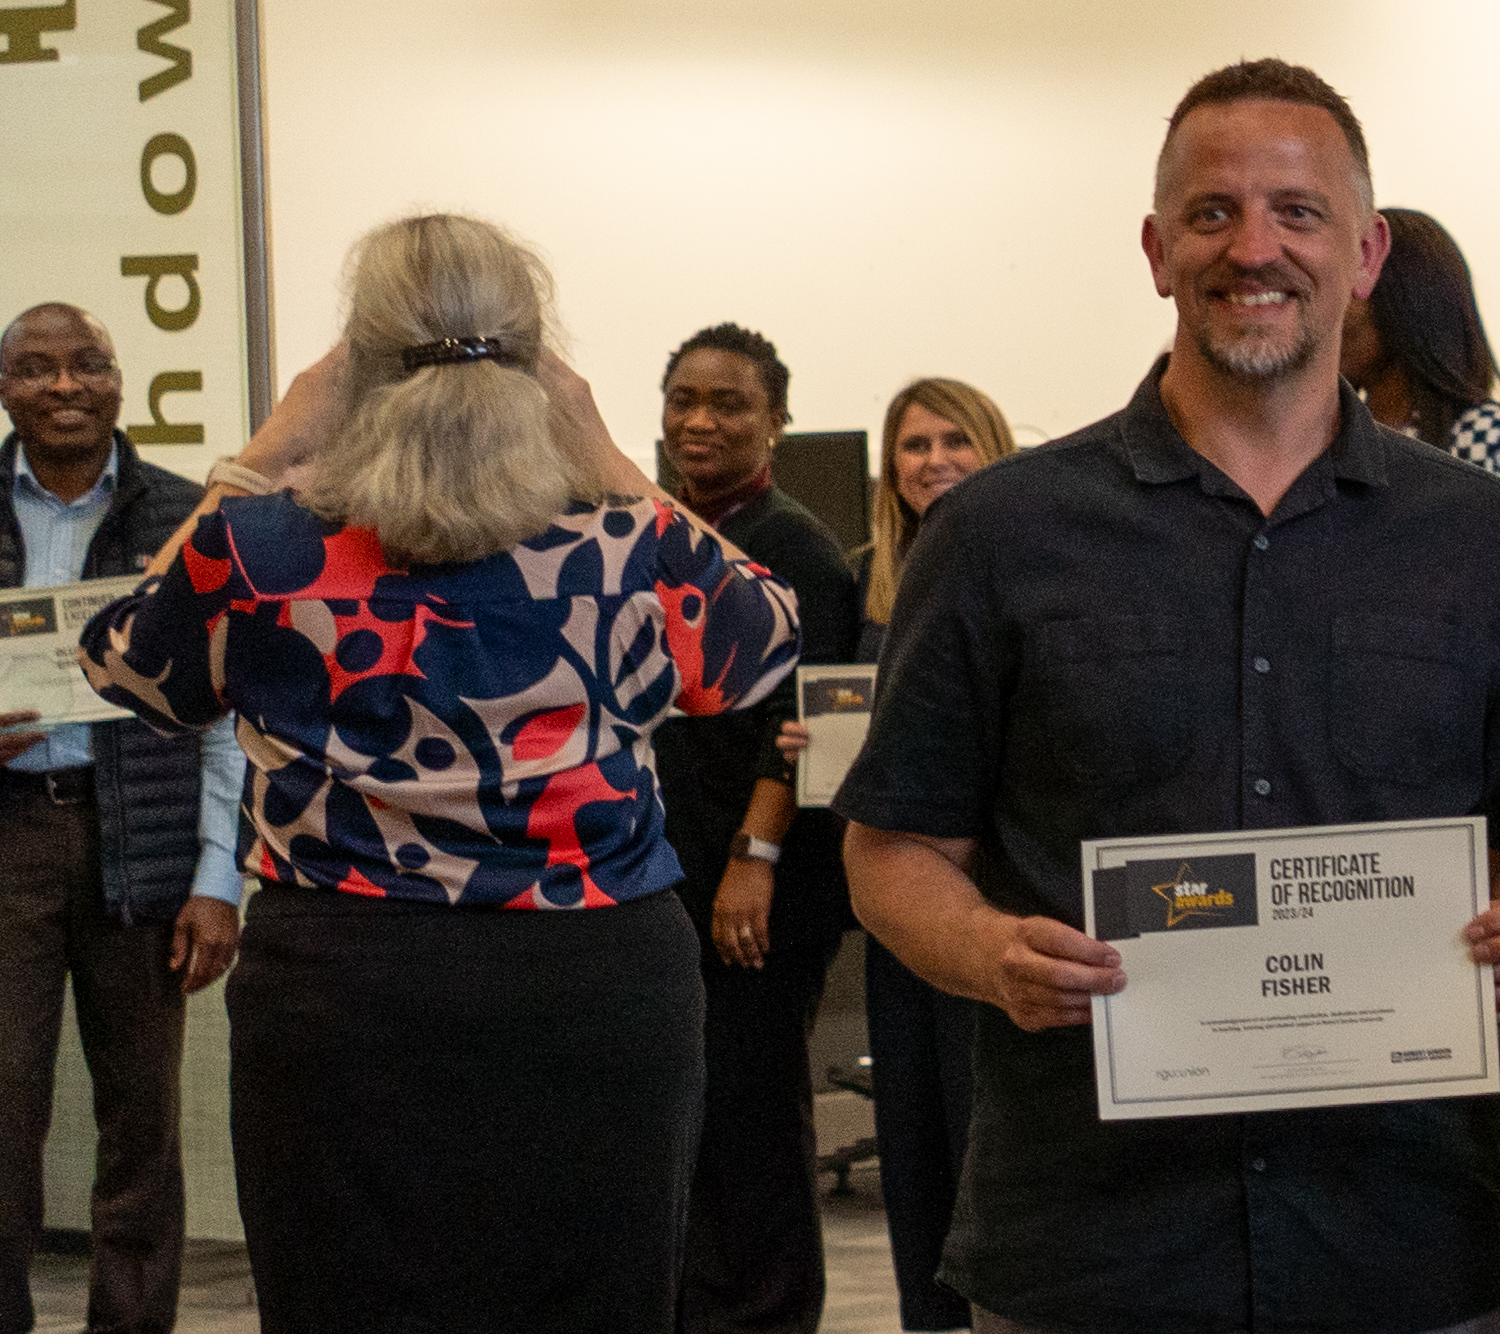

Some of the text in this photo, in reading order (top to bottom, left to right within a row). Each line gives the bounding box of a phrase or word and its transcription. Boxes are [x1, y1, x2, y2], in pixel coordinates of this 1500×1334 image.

[1270, 852, 1381, 880] CERTIFICATE
[1174, 880, 1208, 897] star
[1271, 876, 1415, 906] OF RECOGNITION
[1175, 892, 1234, 908] awards
[1266, 953, 1324, 973] COLIN
[1261, 976, 1331, 997] FISHER
